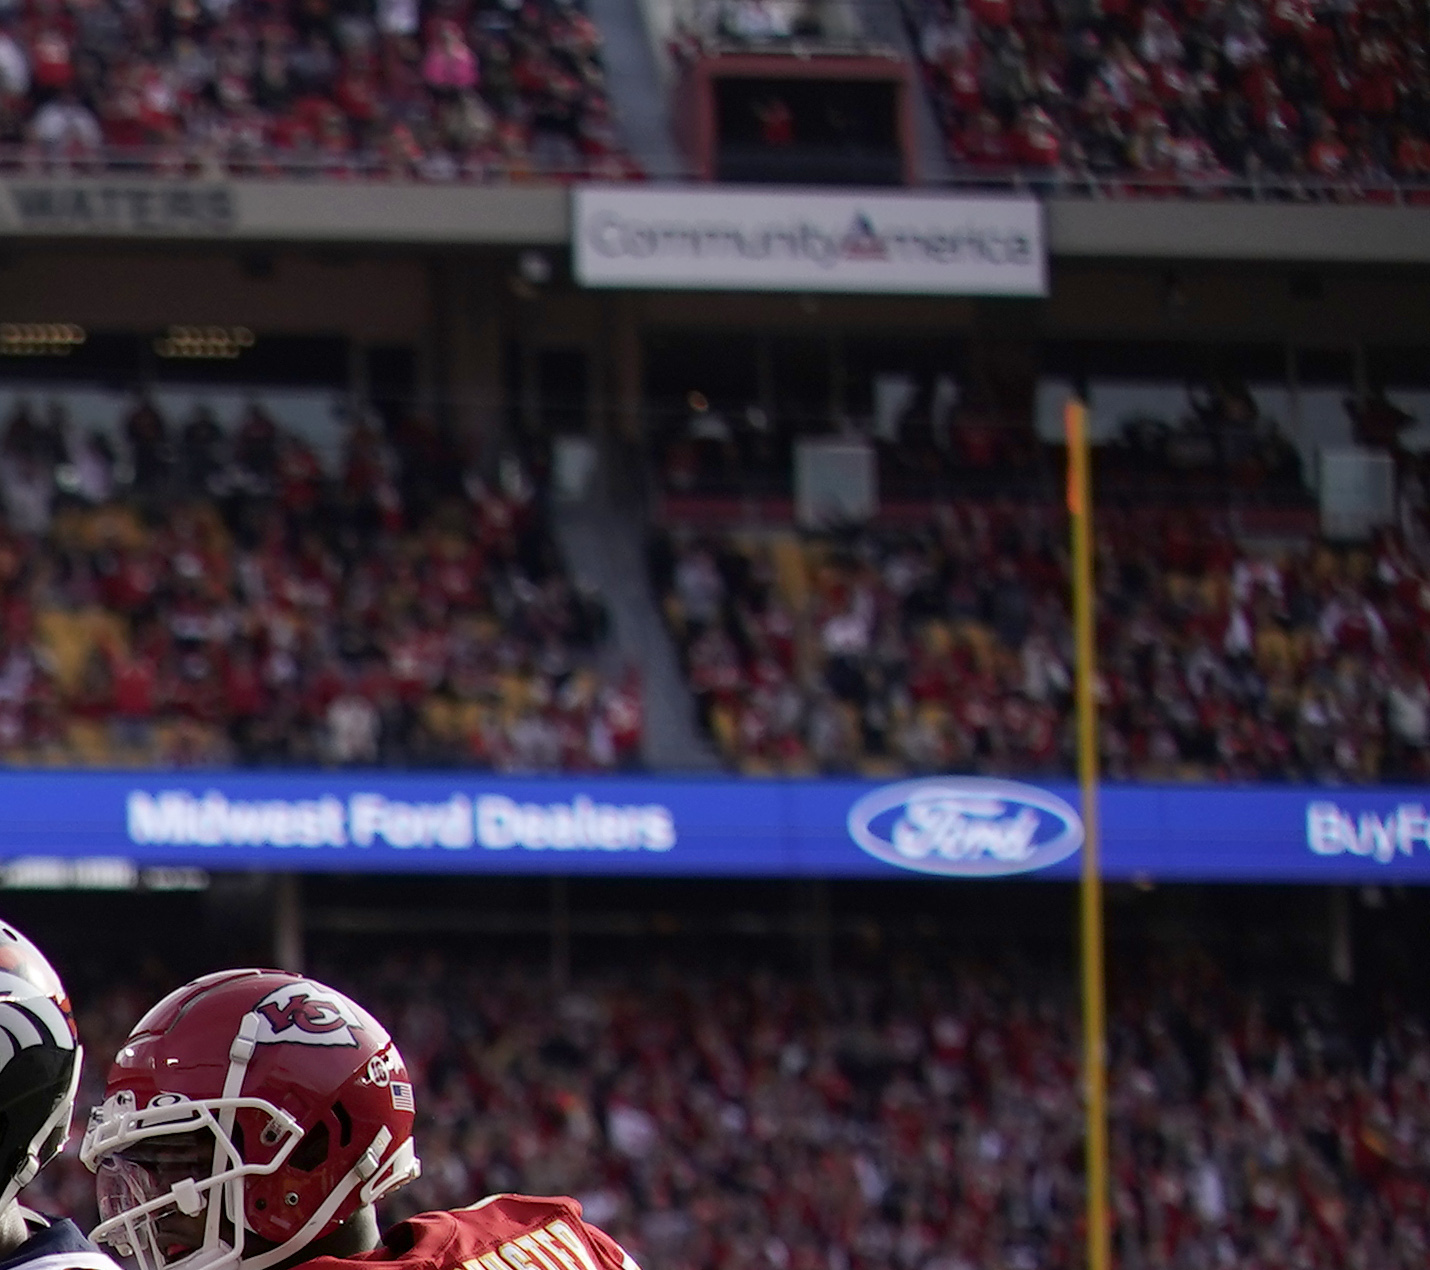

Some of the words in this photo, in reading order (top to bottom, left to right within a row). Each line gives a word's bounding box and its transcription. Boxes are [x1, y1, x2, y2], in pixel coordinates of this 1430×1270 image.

[9, 186, 241, 233] WATERS
[126, 789, 347, 848] Midwest
[349, 792, 474, 850] Ford
[475, 793, 677, 852] Dealers
[890, 790, 1042, 862] Ford
[1305, 800, 1430, 866] BuyF
